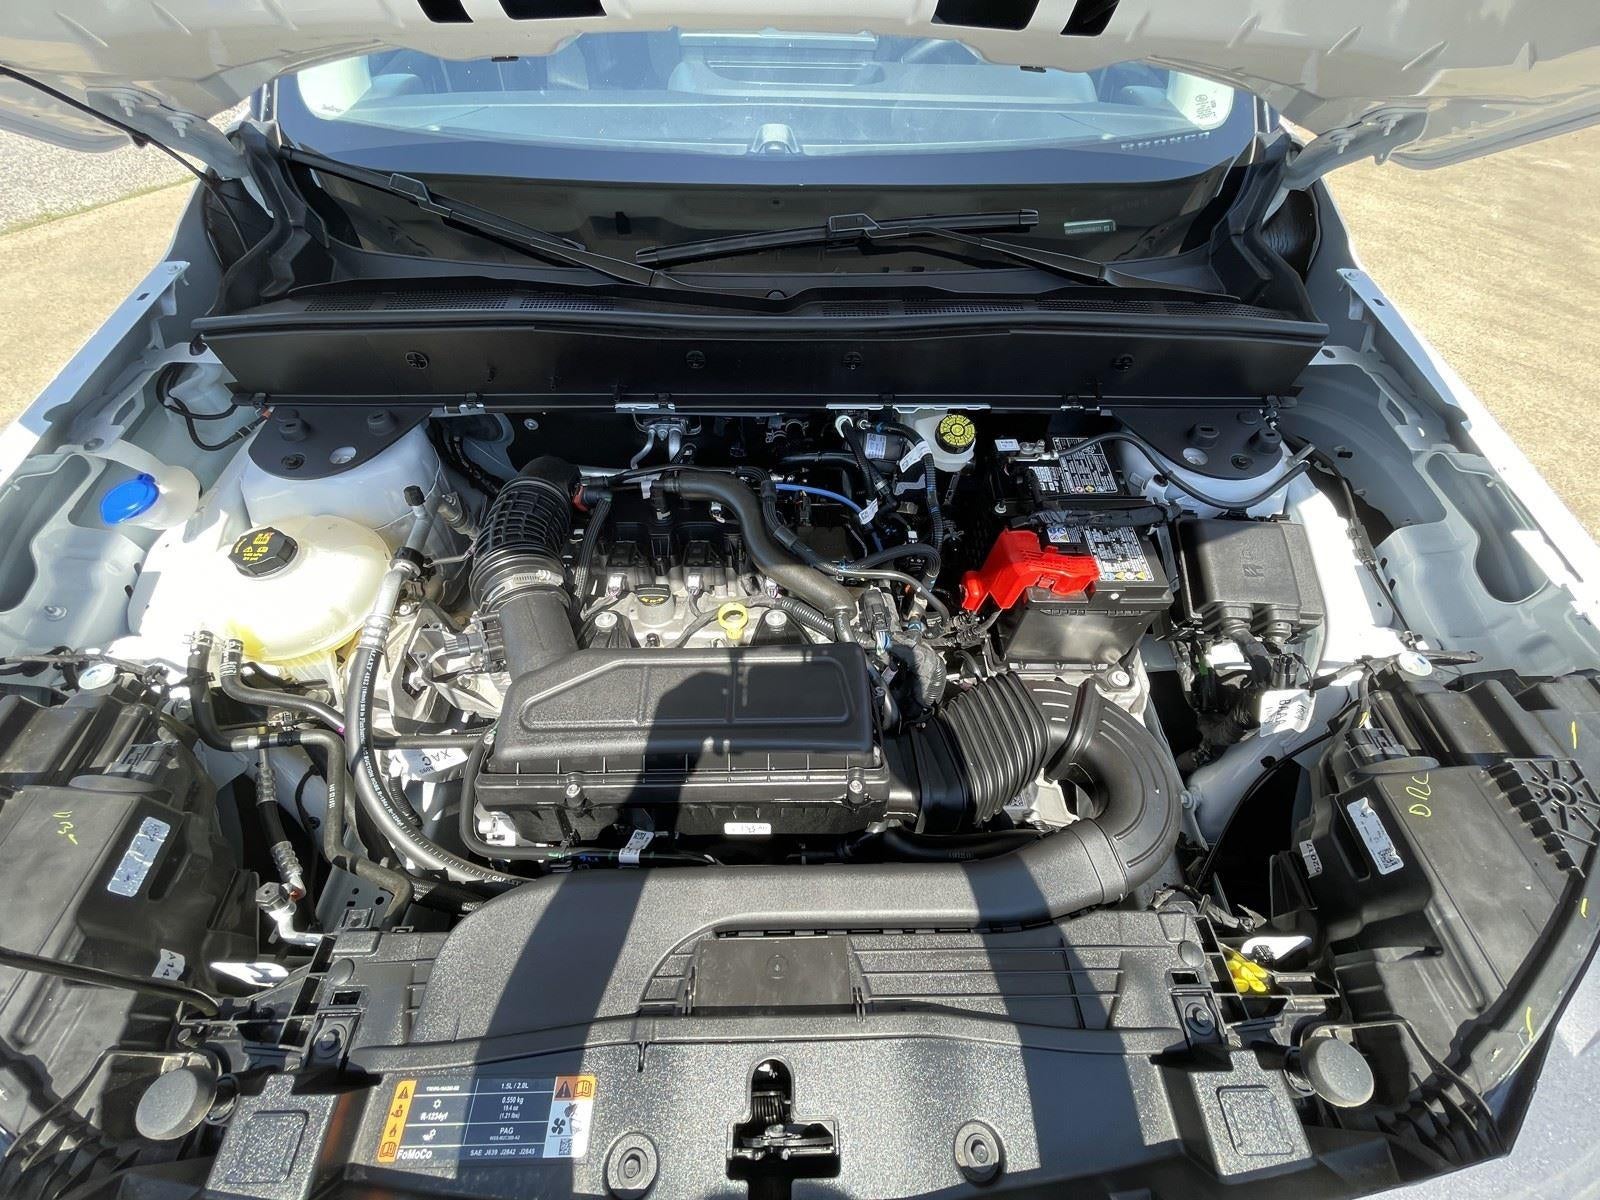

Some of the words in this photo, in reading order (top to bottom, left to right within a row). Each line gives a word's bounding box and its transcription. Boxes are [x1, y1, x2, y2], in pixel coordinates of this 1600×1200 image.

[499, 1127, 515, 1135] PAG
[396, 1148, 433, 1160] FoMoCo
[470, 1149, 483, 1157] SAE
